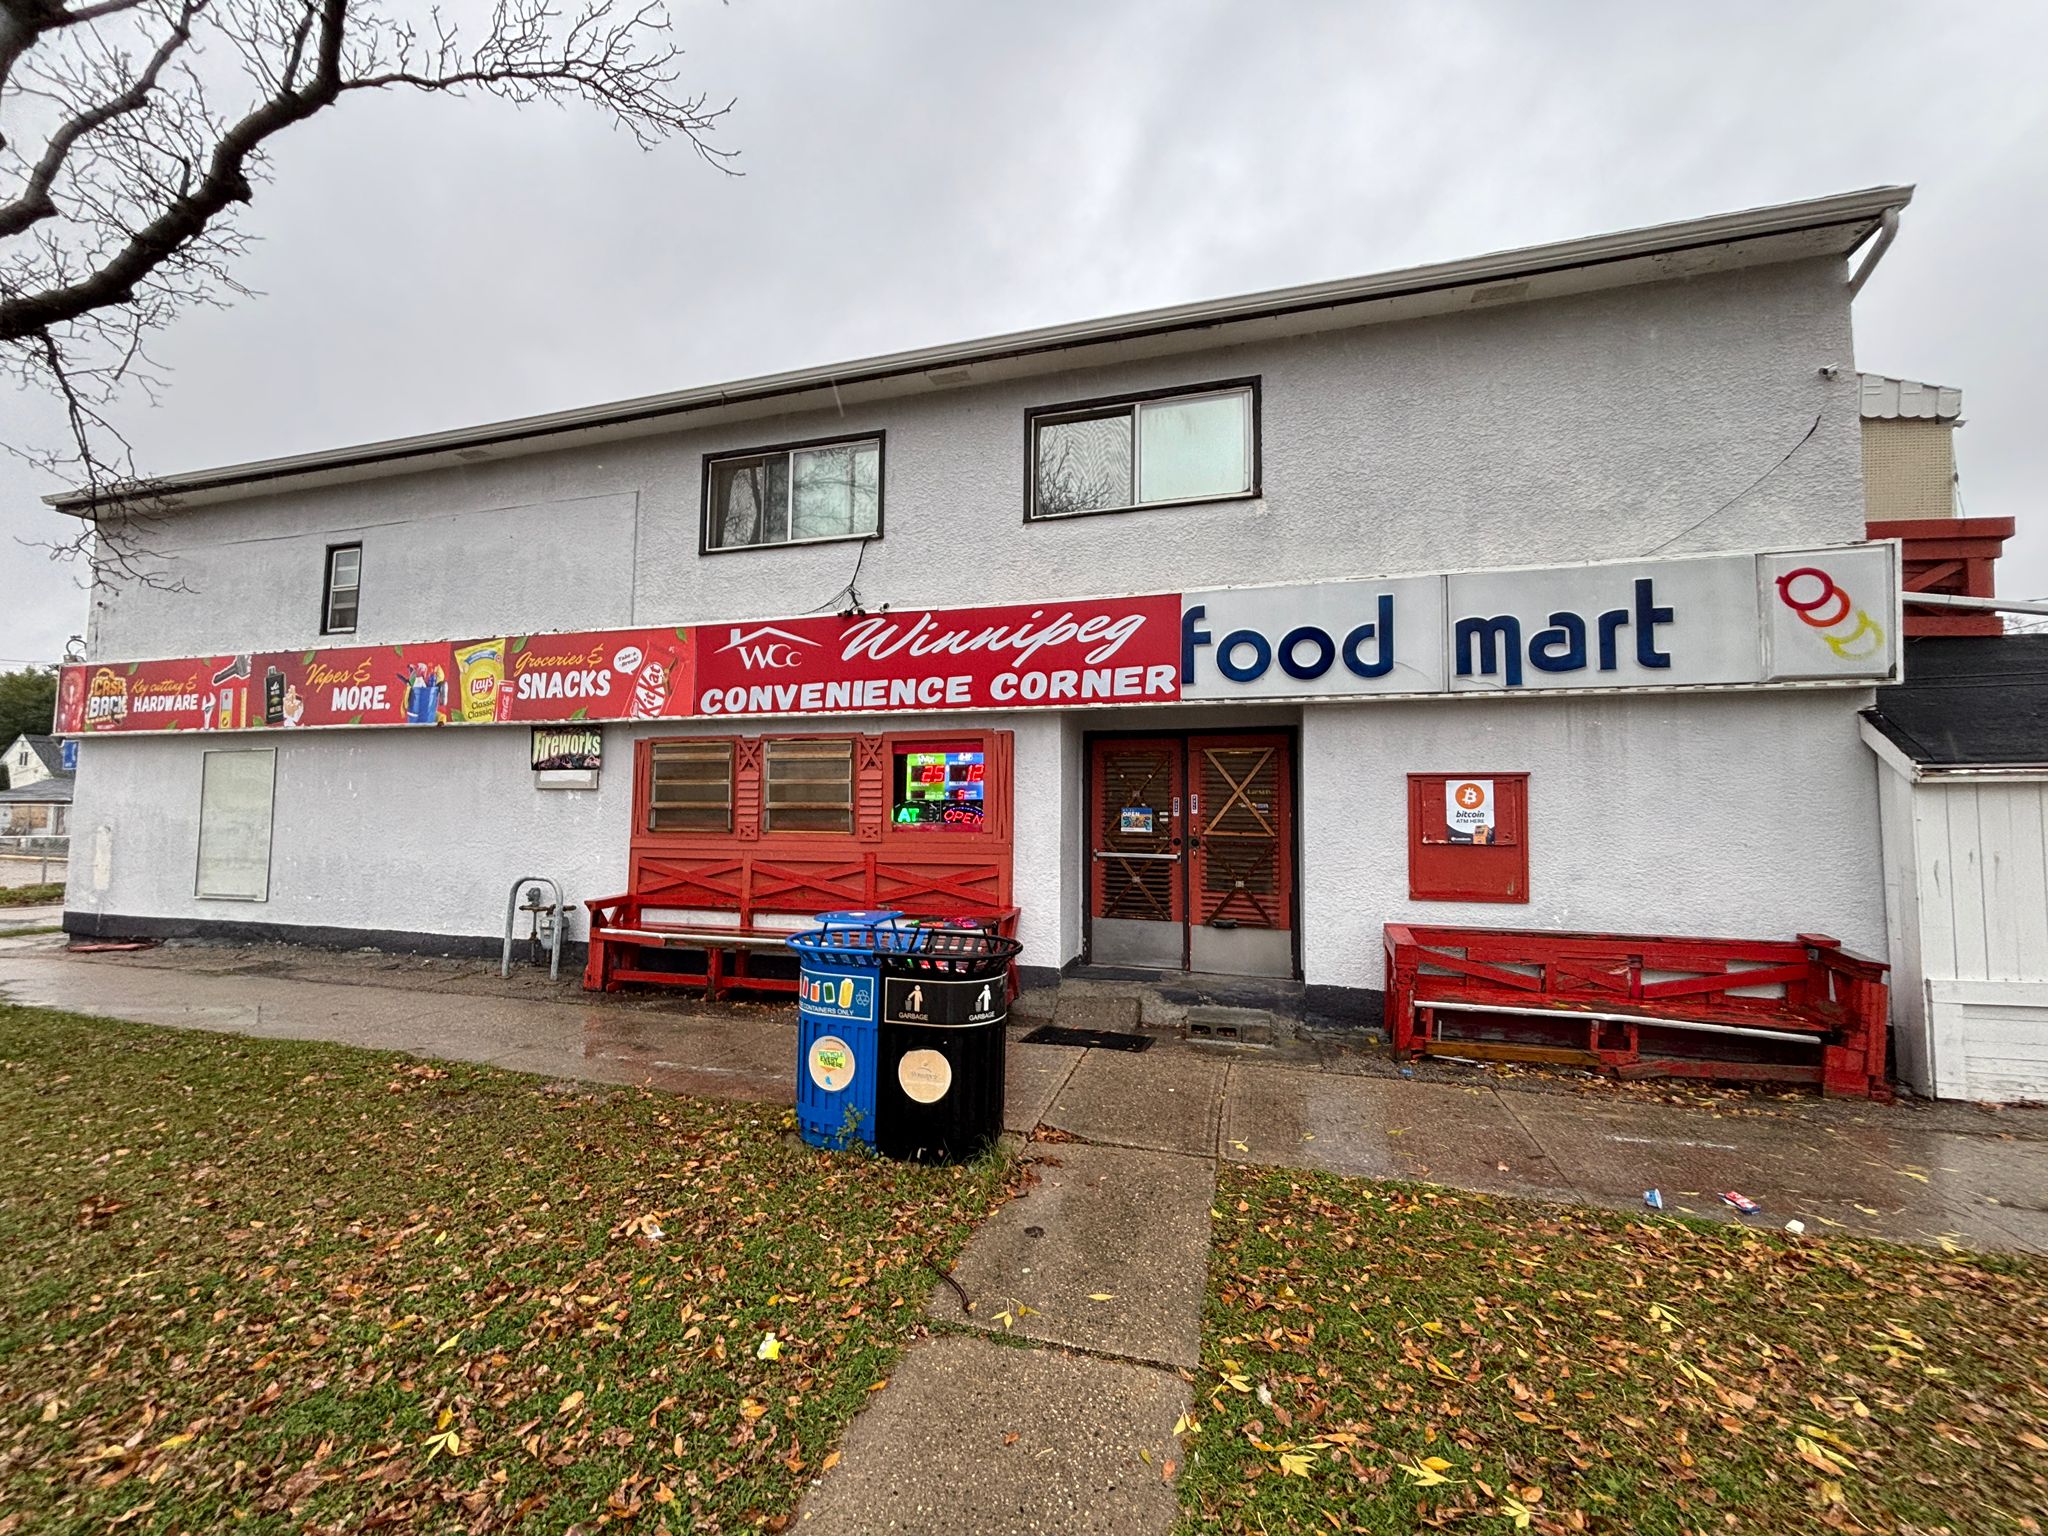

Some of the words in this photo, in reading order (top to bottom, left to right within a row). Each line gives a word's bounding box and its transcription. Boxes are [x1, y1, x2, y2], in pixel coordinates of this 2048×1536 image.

[839, 610, 1147, 668] Winnipeg
[1181, 594, 1394, 684] food
[1454, 579, 1674, 686] mart
[514, 651, 585, 677] Groceries
[587, 643, 604, 668] &
[131, 679, 148, 697] Key
[150, 679, 184, 697] cutting
[186, 673, 198, 692] &
[305, 664, 351, 693] Vapes
[353, 657, 372, 686] &
[517, 669, 611, 700] SNACKS
[94, 680, 124, 695] CASH
[331, 685, 391, 711] MORE.
[700, 676, 973, 714] CONVENIENCE
[990, 665, 1177, 701] CORNER
[88, 695, 126, 719] BACK
[133, 694, 199, 712] HARDWARE
[532, 731, 601, 764] Fireworks
[922, 765, 945, 782] 25
[967, 765, 985, 782] 12
[944, 810, 984, 825] OPEN
[837, 1008, 854, 1016] ONLY
[899, 1012, 928, 1020] GARBAGE
[969, 1011, 995, 1021] GARBAGE
